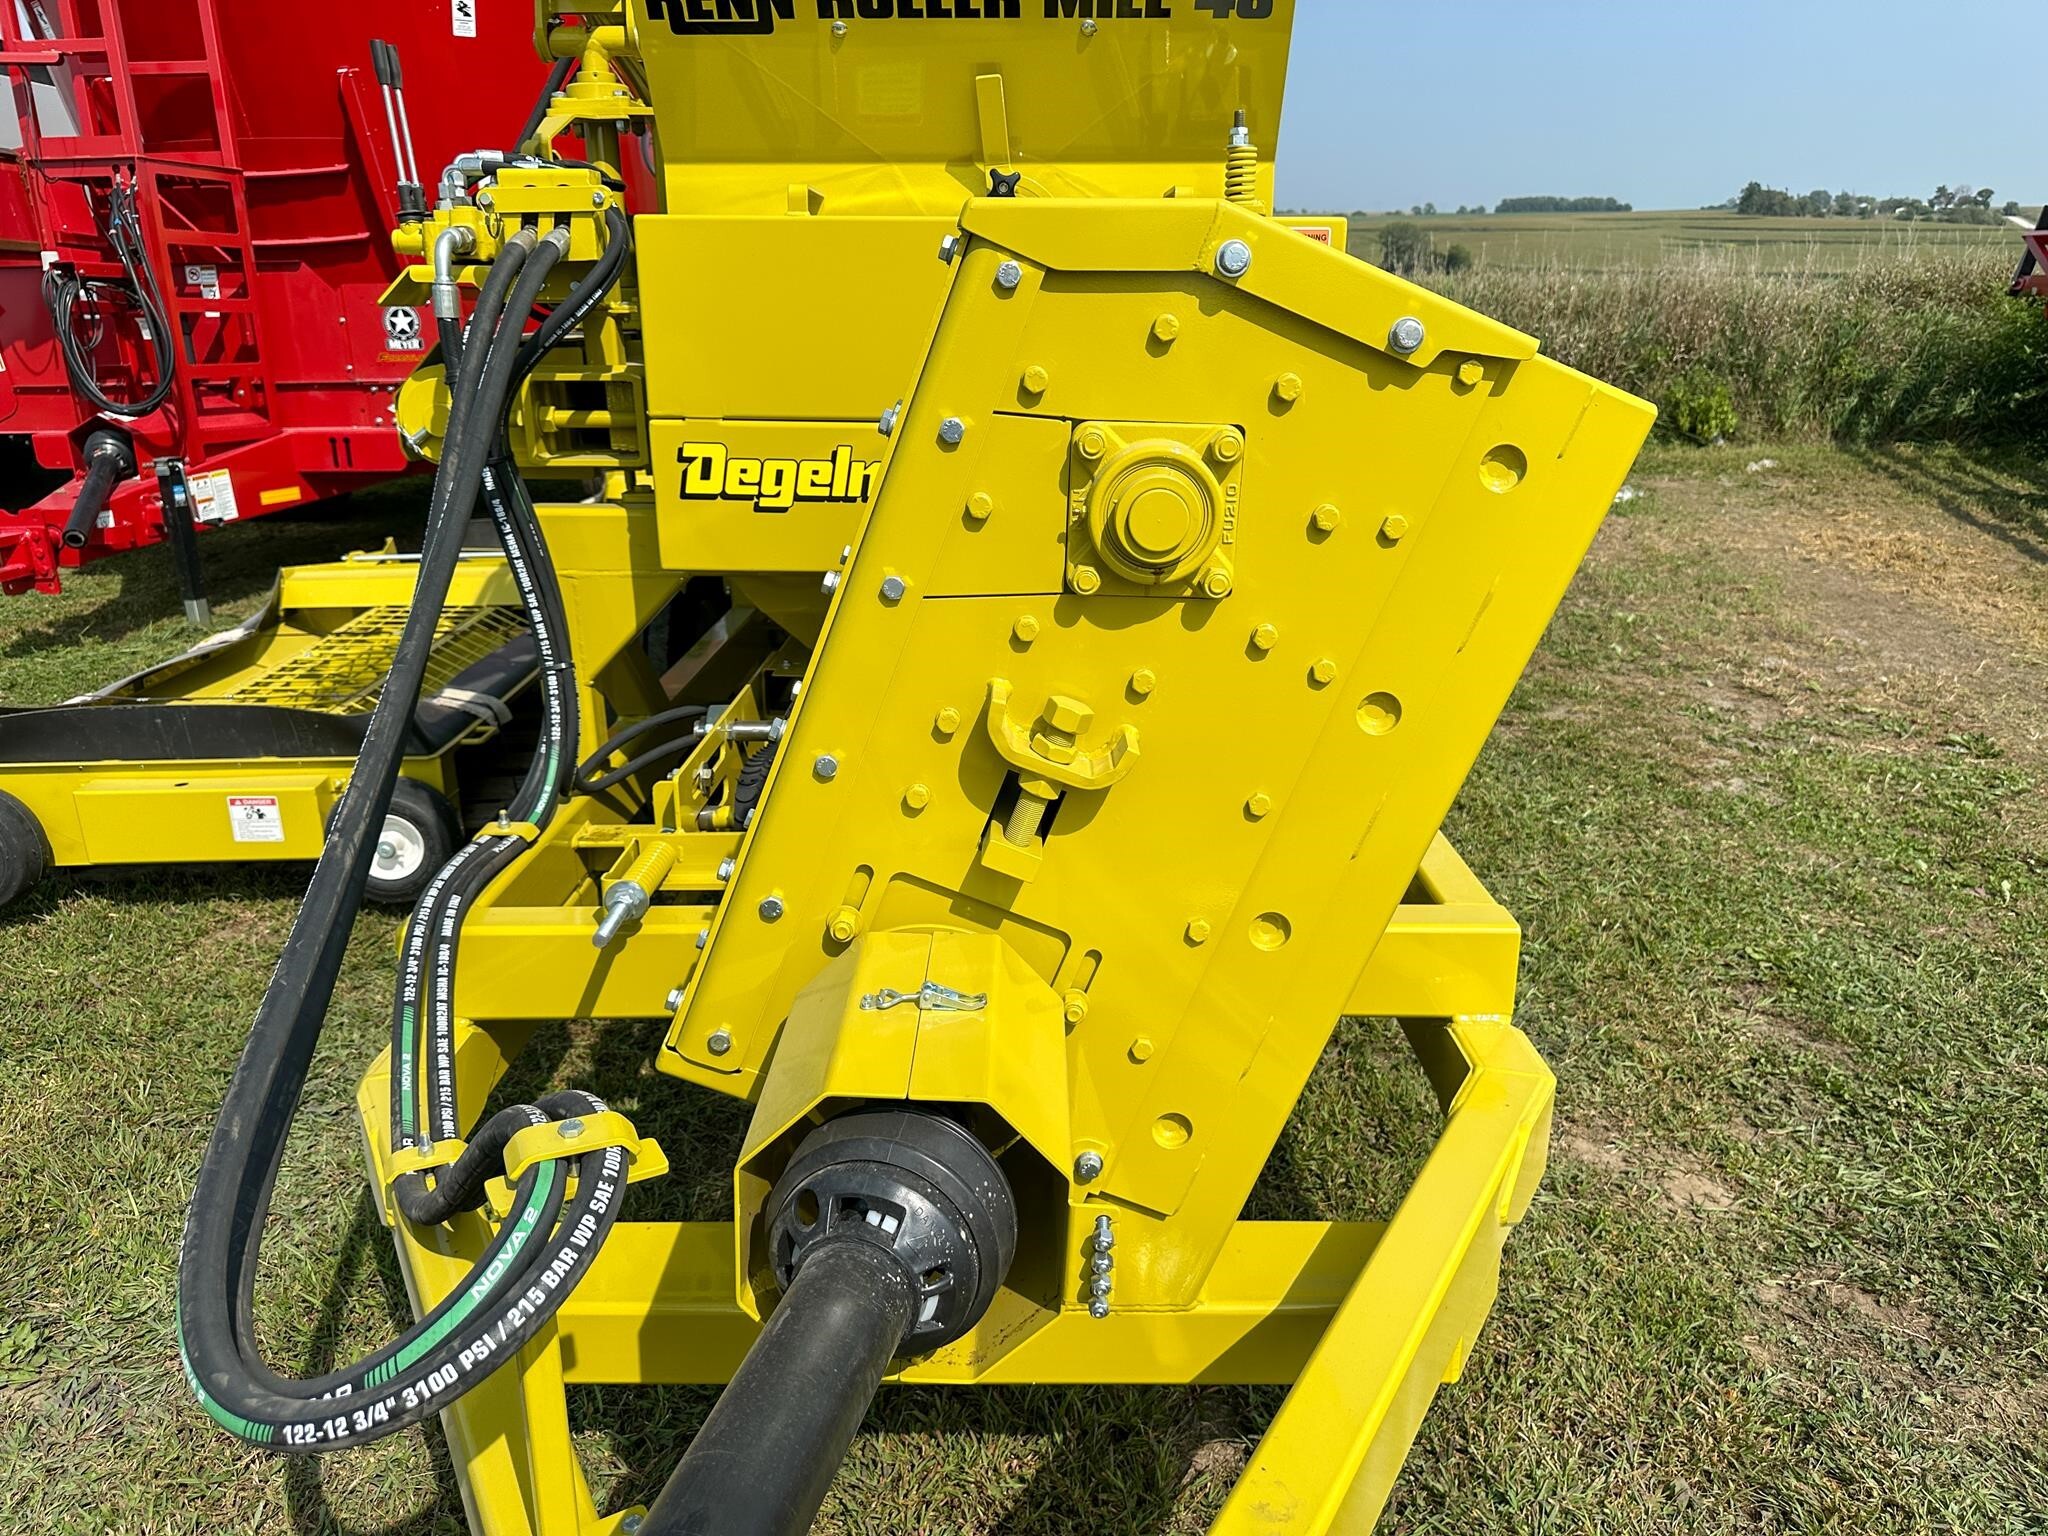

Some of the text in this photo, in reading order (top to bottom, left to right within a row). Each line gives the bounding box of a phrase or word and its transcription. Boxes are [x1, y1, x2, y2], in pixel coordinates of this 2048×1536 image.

[526, 592, 538, 608] SAE
[531, 609, 543, 622] WP
[535, 623, 548, 639] BAR
[441, 917, 455, 937] MADE
[403, 974, 417, 1001] 122-12
[436, 977, 449, 1001] MSHA
[436, 1002, 448, 1036] 100R2AT
[437, 1037, 449, 1053] SAE
[438, 1054, 450, 1069] WP
[402, 1053, 412, 1090] NOVA 2
[438, 1070, 451, 1086] BAR
[439, 1087, 452, 1102] 215
[441, 1108, 454, 1121] PSI
[470, 1206, 539, 1300] NOVA 2
[283, 1416, 349, 1445] 122-12
[352, 1396, 396, 1432] 3/4"
[402, 1363, 459, 1409] 3100
[458, 1333, 498, 1372] PSI
[497, 1320, 507, 1342] /
[507, 1286, 546, 1328] 215
[540, 1247, 579, 1289] BAR
[570, 1213, 598, 1247] WP
[589, 1180, 614, 1214] SAE
